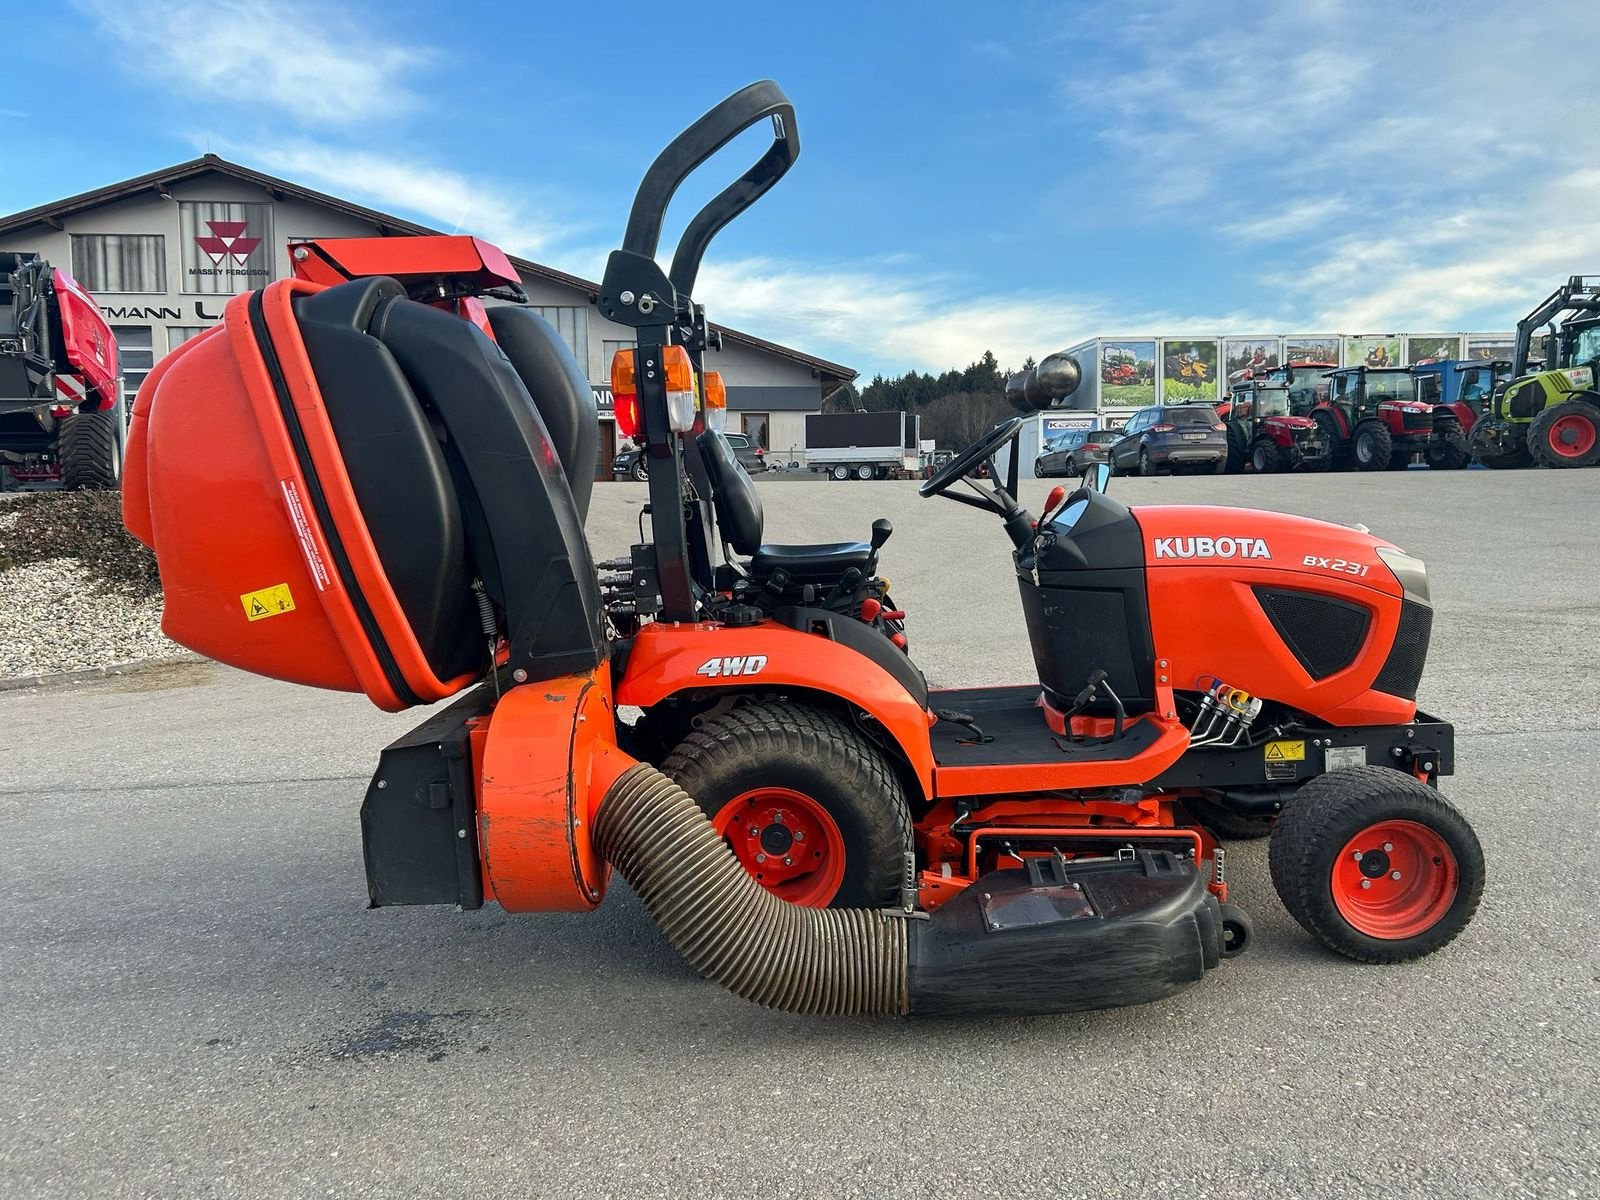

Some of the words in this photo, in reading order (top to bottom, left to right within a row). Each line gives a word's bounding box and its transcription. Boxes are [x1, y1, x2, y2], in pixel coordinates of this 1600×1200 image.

[189, 268, 223, 276] MASSEY
[195, 301, 224, 320] L
[1154, 536, 1272, 560] KUBOTA
[696, 655, 768, 678] 4WD
